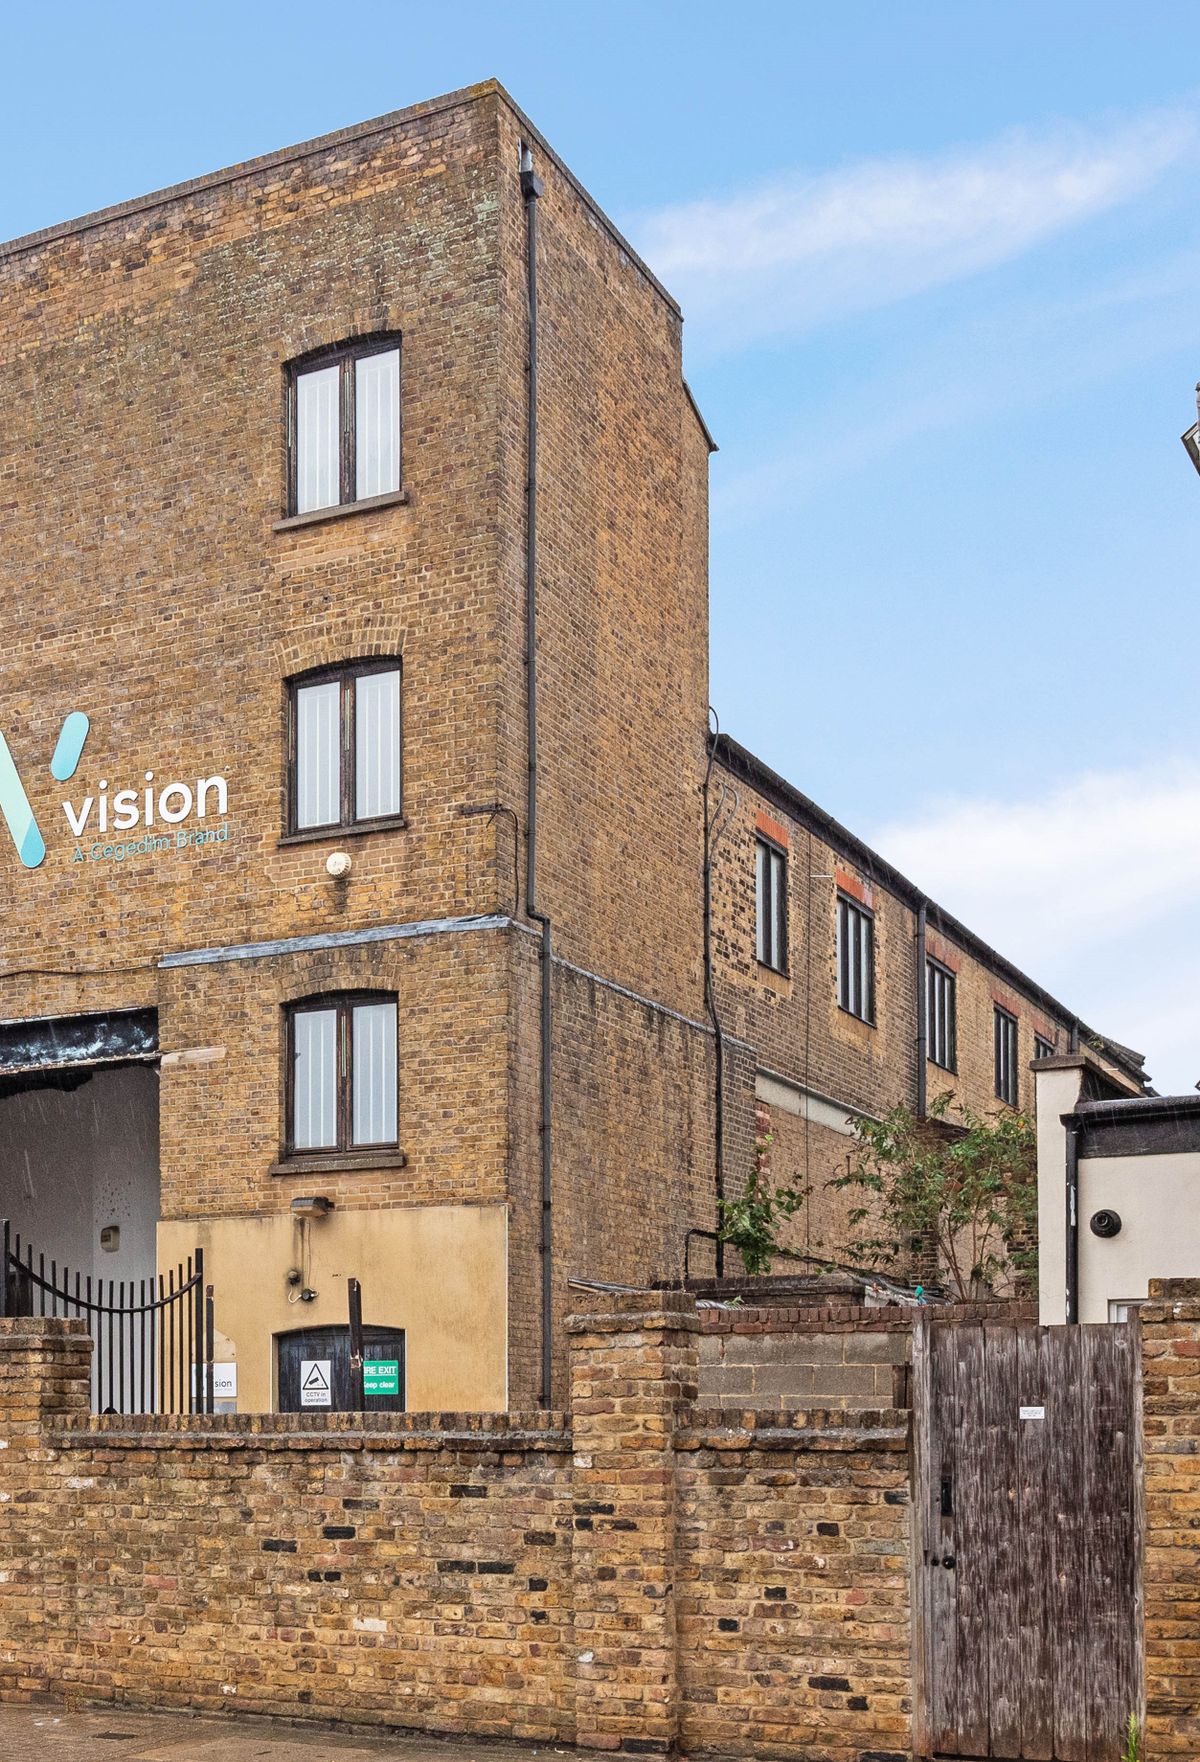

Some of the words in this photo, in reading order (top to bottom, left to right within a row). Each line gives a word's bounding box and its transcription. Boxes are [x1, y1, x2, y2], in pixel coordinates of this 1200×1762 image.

[61, 771, 228, 837] vision
[71, 847, 85, 863] A
[90, 834, 171, 862] Cegedim
[176, 823, 229, 848] Brand
[364, 1366, 377, 1375] IRE
[378, 1366, 397, 1375] EXIT
[214, 1378, 233, 1388] sion
[379, 1381, 395, 1389] clear
